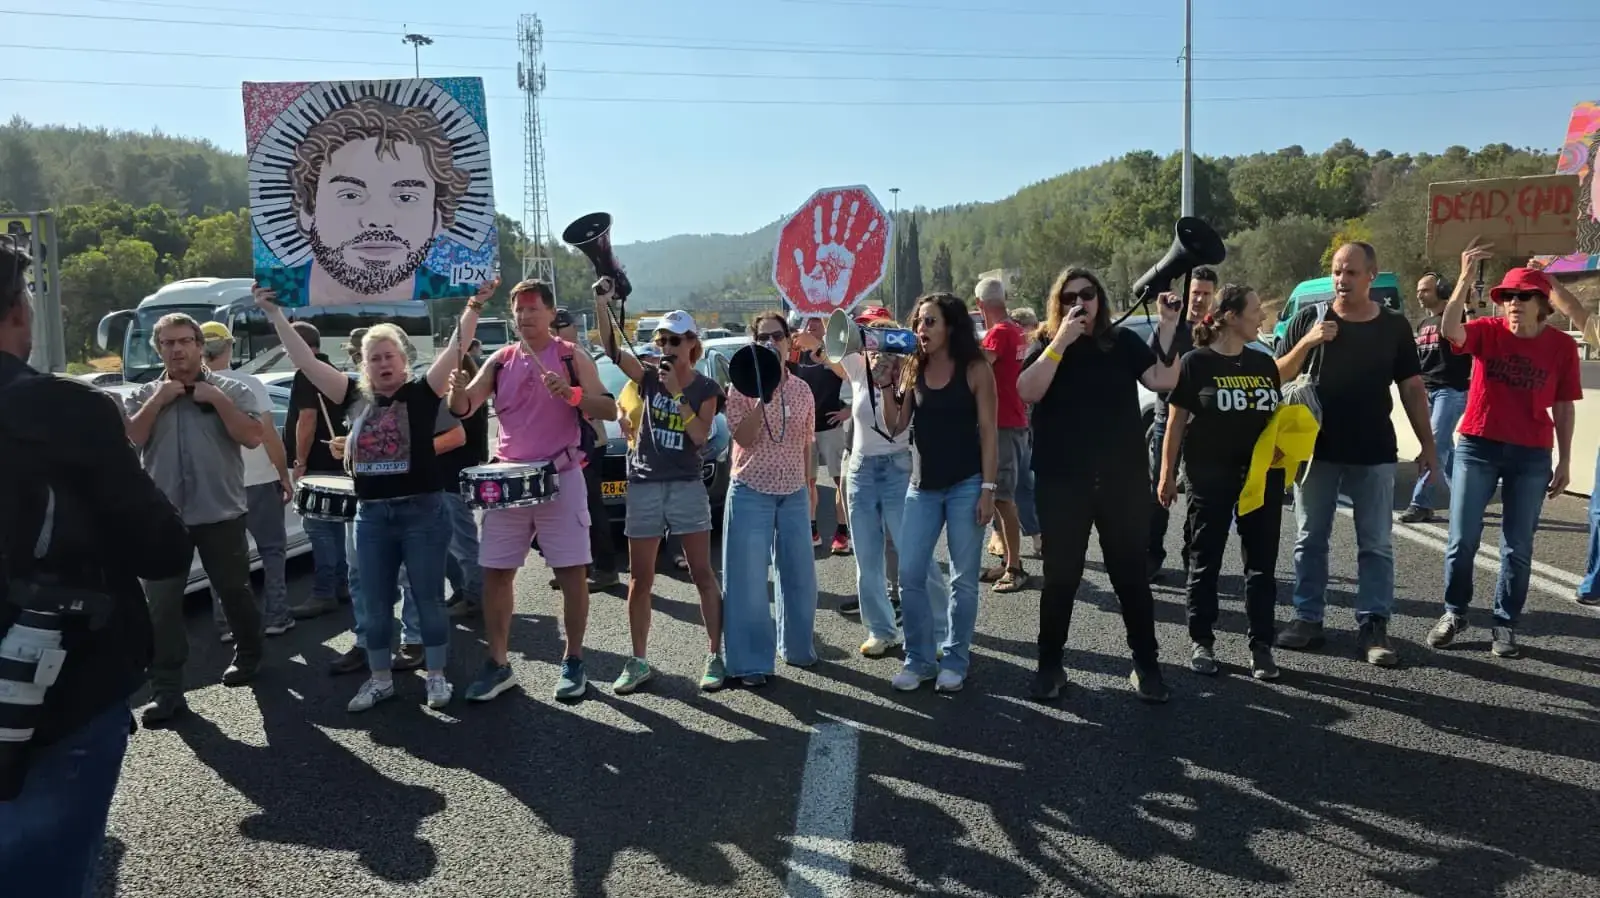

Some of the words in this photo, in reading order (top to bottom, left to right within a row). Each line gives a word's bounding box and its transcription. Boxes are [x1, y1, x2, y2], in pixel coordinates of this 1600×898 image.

[453, 263, 487, 285] אלון
[1213, 376, 1270, 390] באוקטובר
[1216, 388, 1279, 412] 06:29
